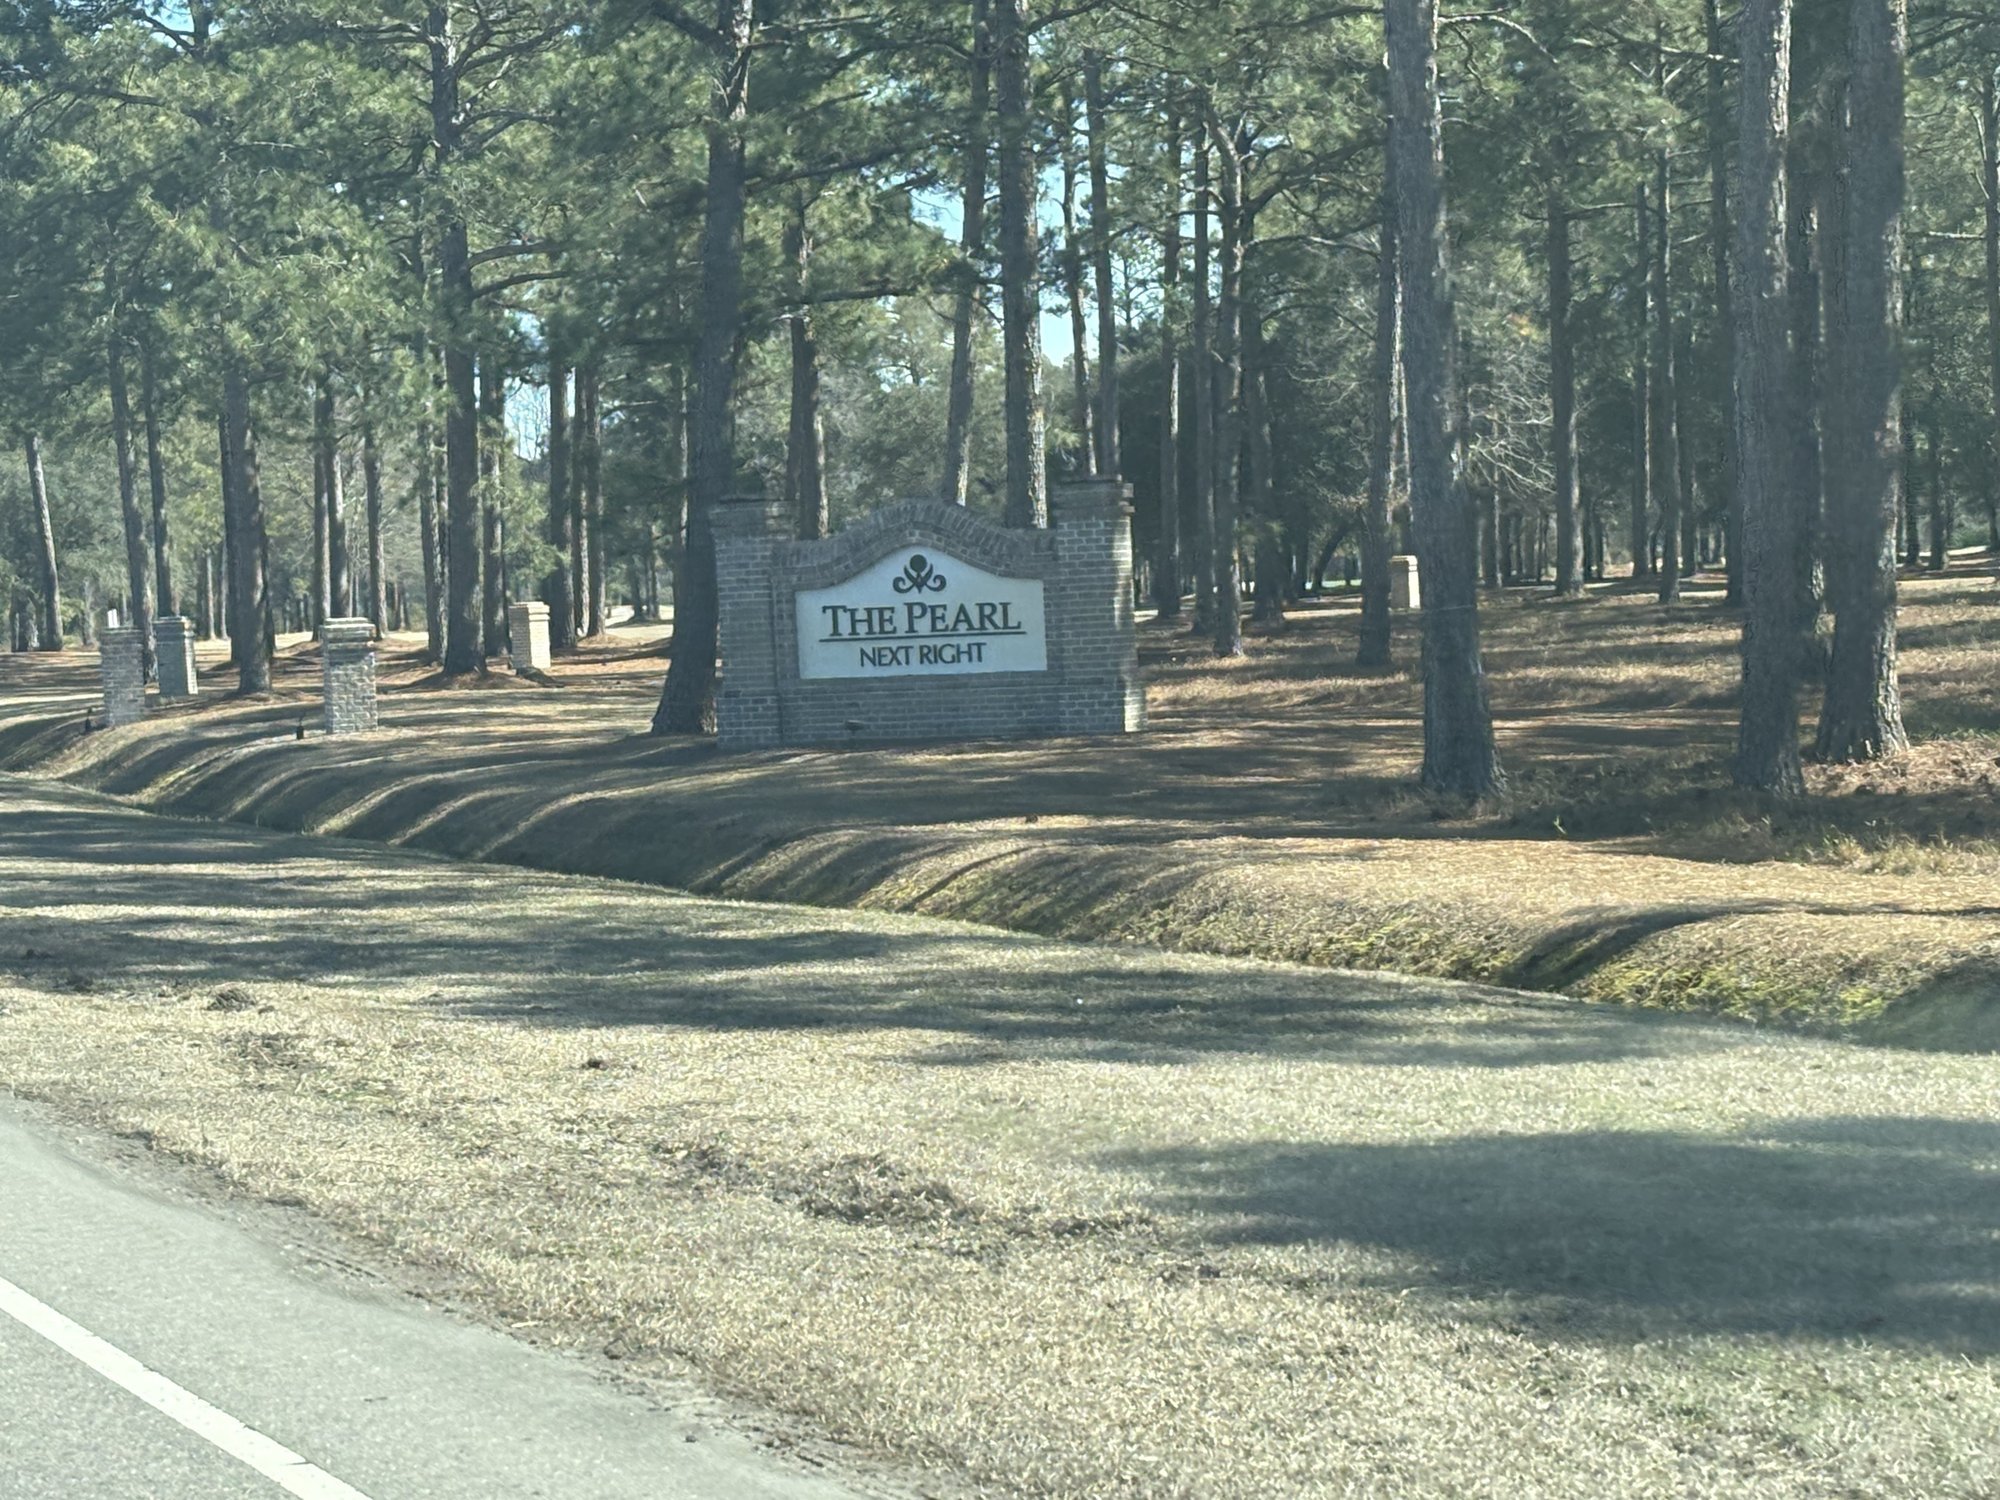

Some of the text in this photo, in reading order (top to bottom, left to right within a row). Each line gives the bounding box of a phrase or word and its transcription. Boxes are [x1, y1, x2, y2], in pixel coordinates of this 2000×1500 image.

[822, 602, 1022, 636] THE PEARL
[860, 642, 987, 667] NEXT RIGHT
